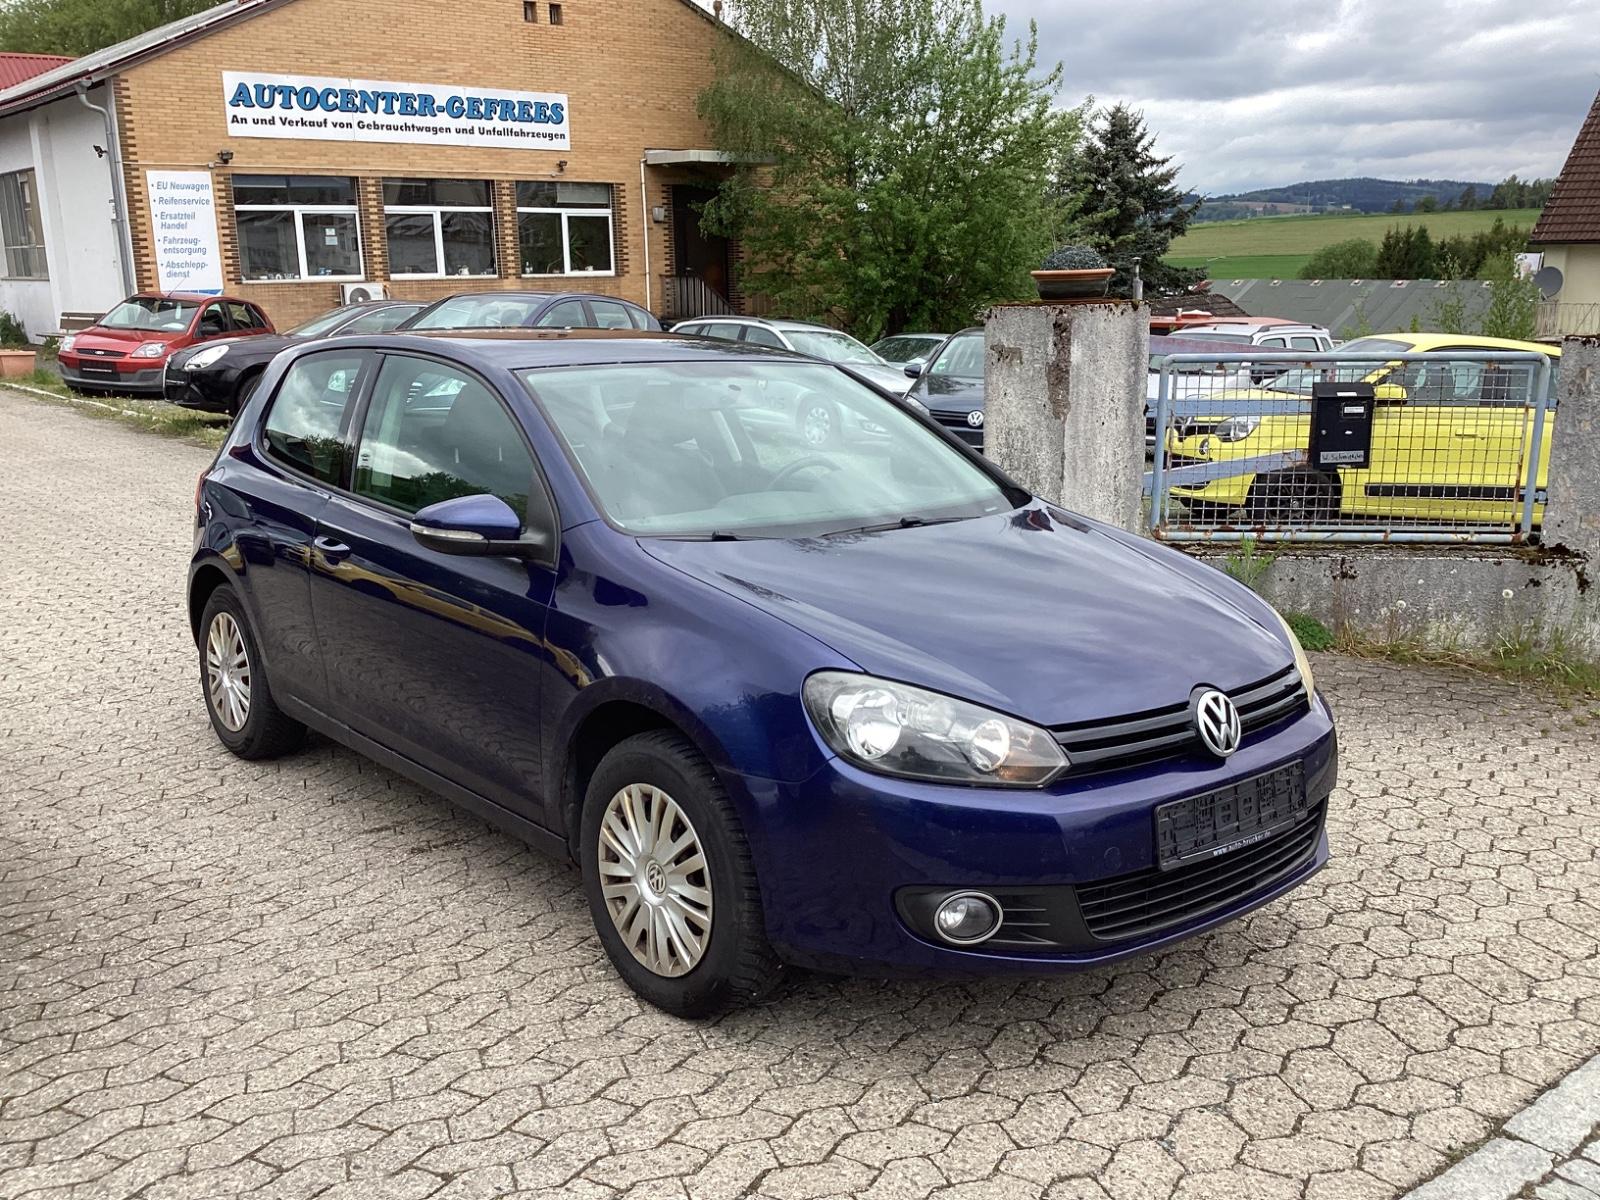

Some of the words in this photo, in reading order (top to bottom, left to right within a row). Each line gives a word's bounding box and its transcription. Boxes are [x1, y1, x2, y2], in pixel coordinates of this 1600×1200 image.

[229, 82, 564, 125] AUTOCENTER-GEFREES
[231, 114, 248, 124] An
[252, 115, 276, 126] und
[280, 116, 328, 128] Verkauf
[332, 121, 353, 129] von
[357, 120, 451, 135] Gebrauchtwagen
[455, 125, 475, 135] und
[479, 126, 566, 141] Unfallfahrzeugen
[156, 181, 168, 190] EU
[170, 181, 210, 192] Neuwagen
[158, 196, 210, 205] Reifenservice
[160, 211, 196, 220] Ersatzteil
[160, 222, 188, 230] Handel
[162, 236, 201, 246] Fahrzeug-
[163, 246, 207, 256] entsorgung
[165, 260, 208, 270] Abschlepp-
[166, 270, 190, 278] dienst
[1197, 691, 1241, 757] VW
